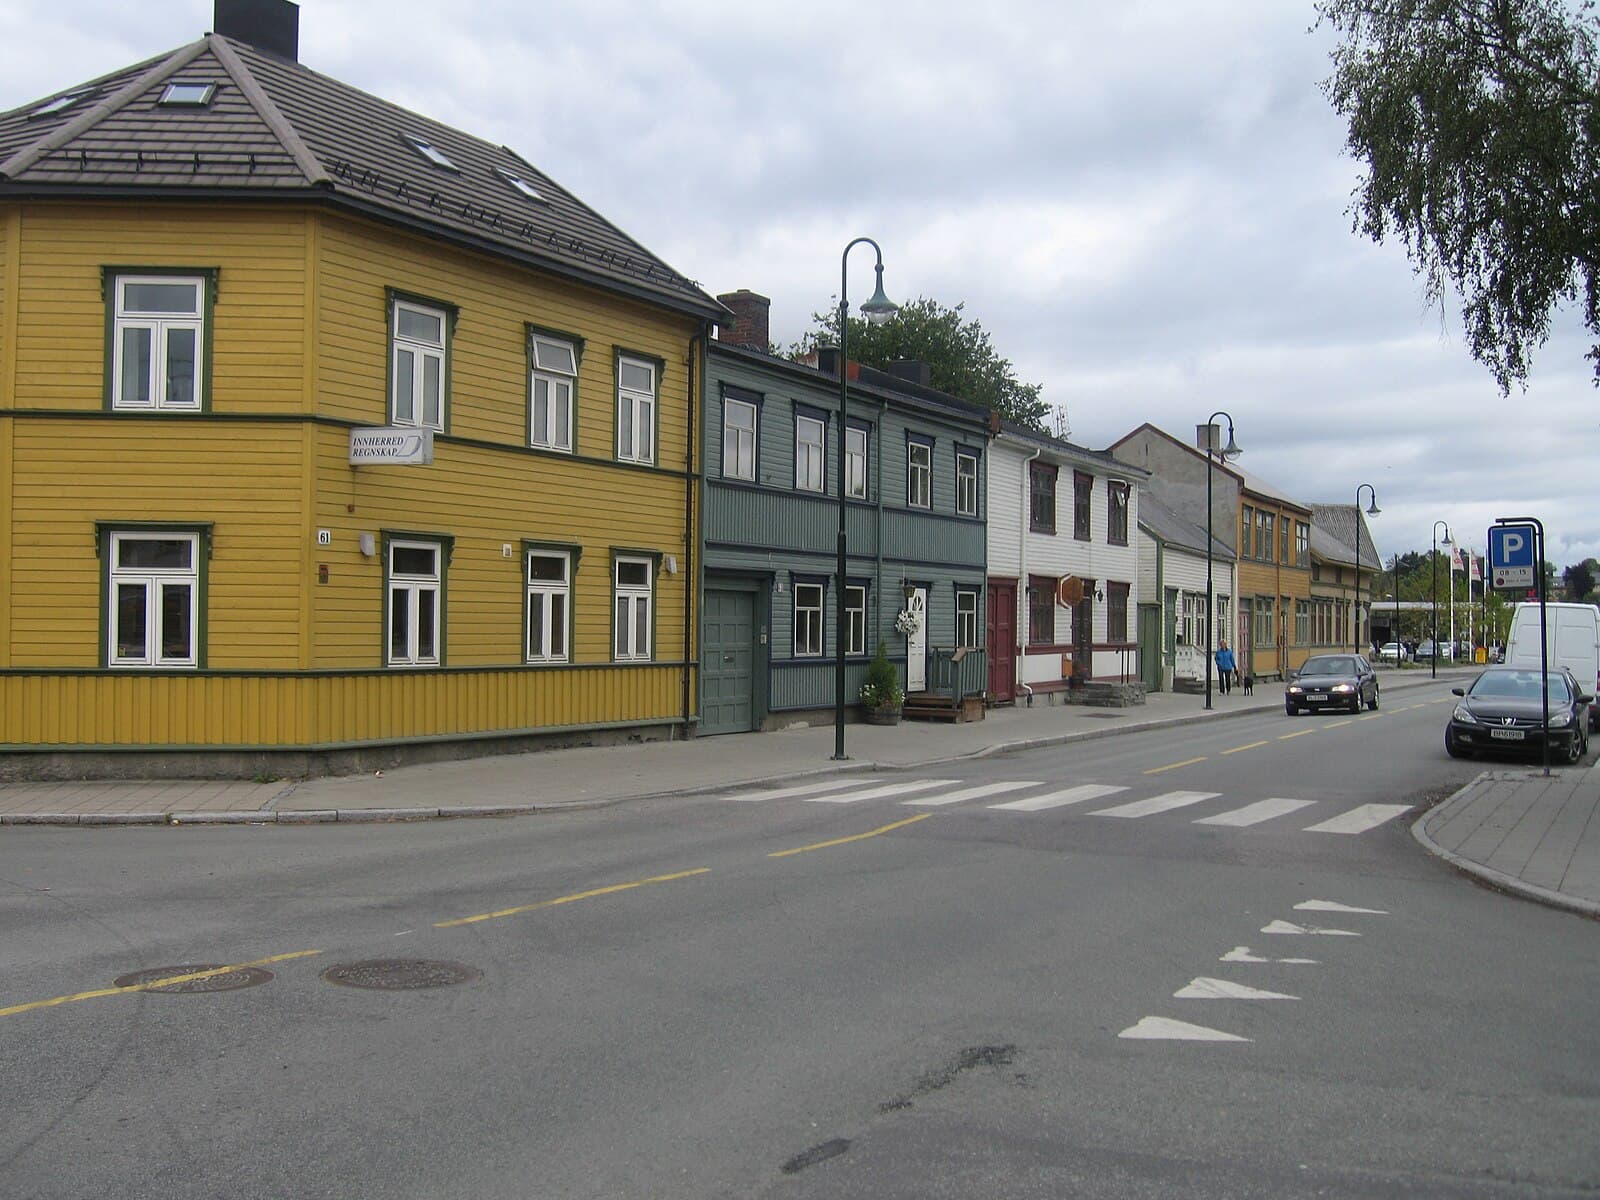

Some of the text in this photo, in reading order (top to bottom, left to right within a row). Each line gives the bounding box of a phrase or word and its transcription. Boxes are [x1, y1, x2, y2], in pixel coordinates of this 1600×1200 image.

[352, 436, 404, 446] INNHERRED
[352, 447, 398, 457] REGNSKAP
[320, 532, 329, 544] 61
[1502, 533, 1524, 563] P
